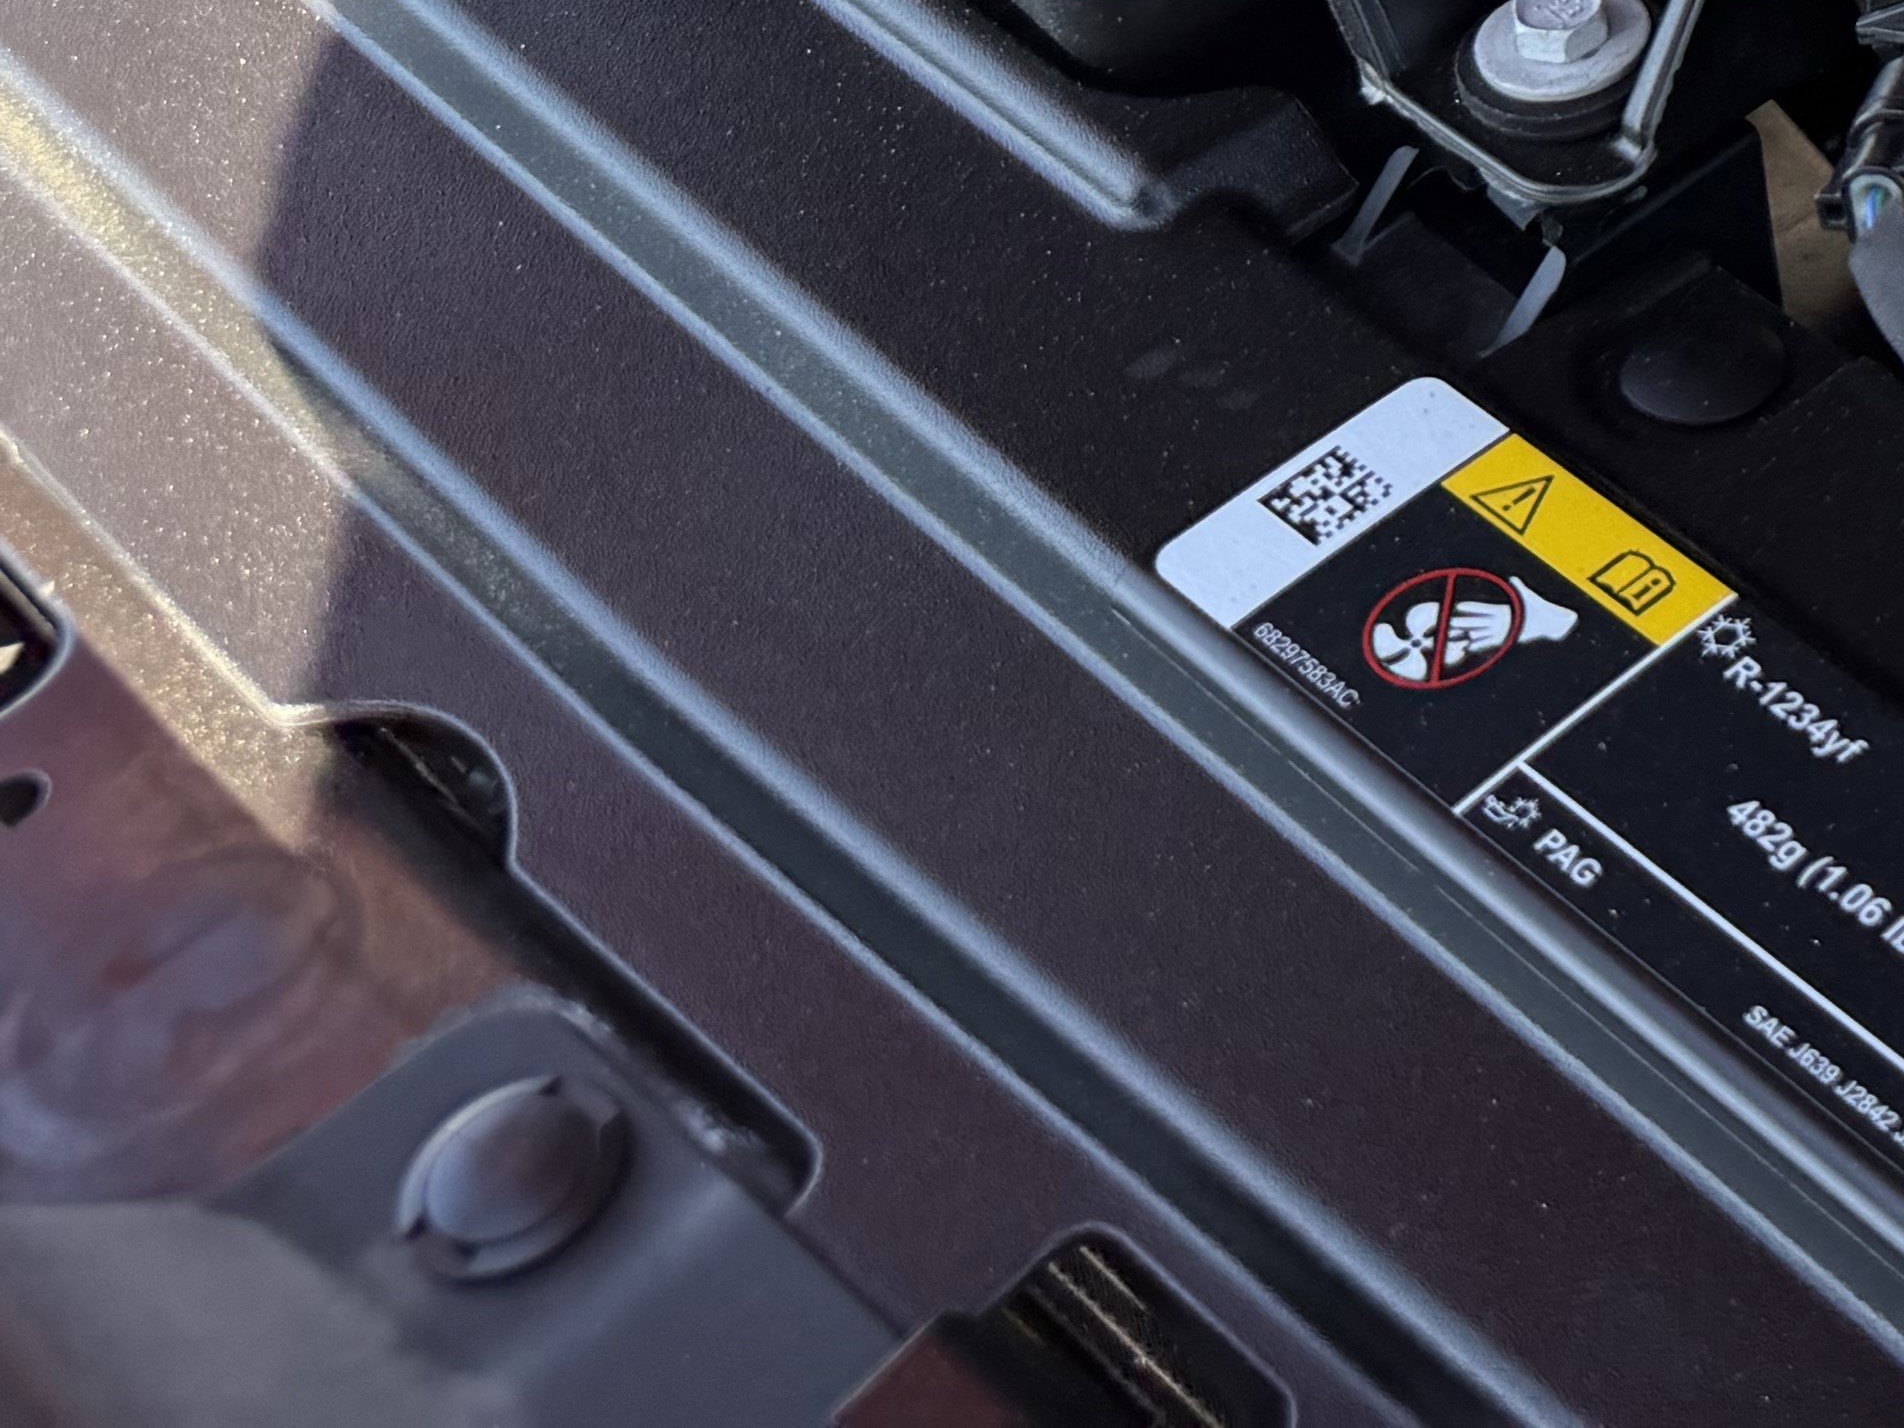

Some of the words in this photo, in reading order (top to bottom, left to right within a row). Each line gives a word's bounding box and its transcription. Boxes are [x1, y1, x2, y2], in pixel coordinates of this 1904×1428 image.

[1253, 622, 1361, 709] 68297583AC
[1723, 656, 1870, 763] R-1234yf
[1533, 828, 1603, 888] PAG
[1727, 800, 1807, 872] 482g
[1797, 855, 1892, 928] (1.06
[1743, 1005, 1796, 1048] SAE
[1786, 1043, 1843, 1086] J639
[1833, 1080, 1901, 1132] J2842
